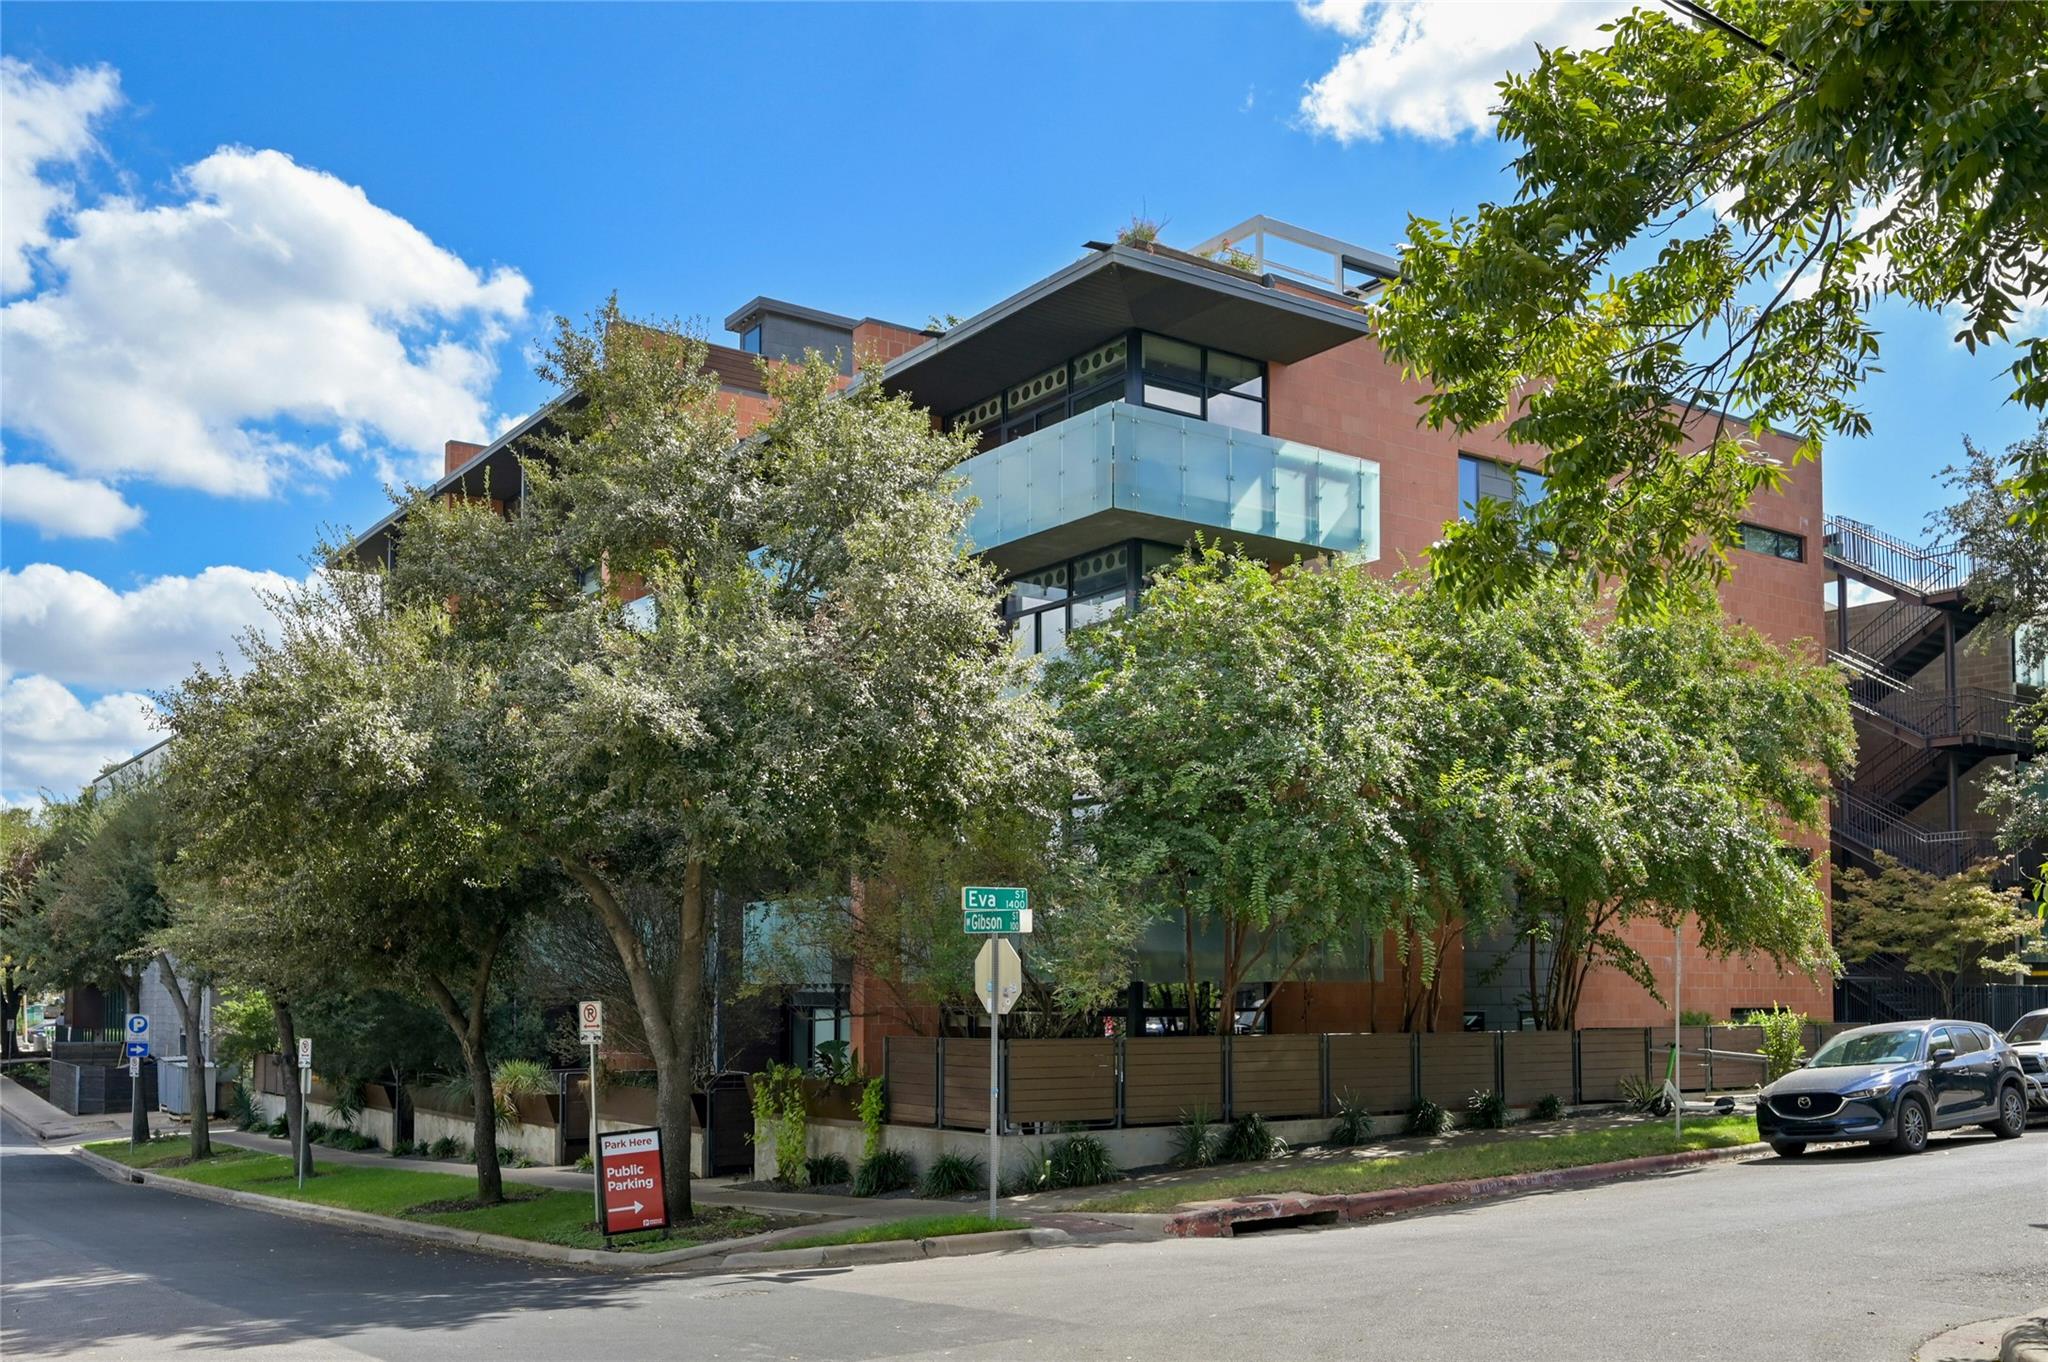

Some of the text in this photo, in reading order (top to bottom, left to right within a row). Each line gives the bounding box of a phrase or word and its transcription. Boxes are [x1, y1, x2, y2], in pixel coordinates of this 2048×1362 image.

[968, 890, 996, 907] Eva
[1014, 890, 1025, 899] ST
[1005, 900, 1026, 909] 1400
[971, 913, 1003, 930] Gibson
[133, 1018, 146, 1032] P
[604, 1137, 653, 1150] Park Here
[606, 1163, 645, 1178] Public
[607, 1176, 654, 1192] Parking
